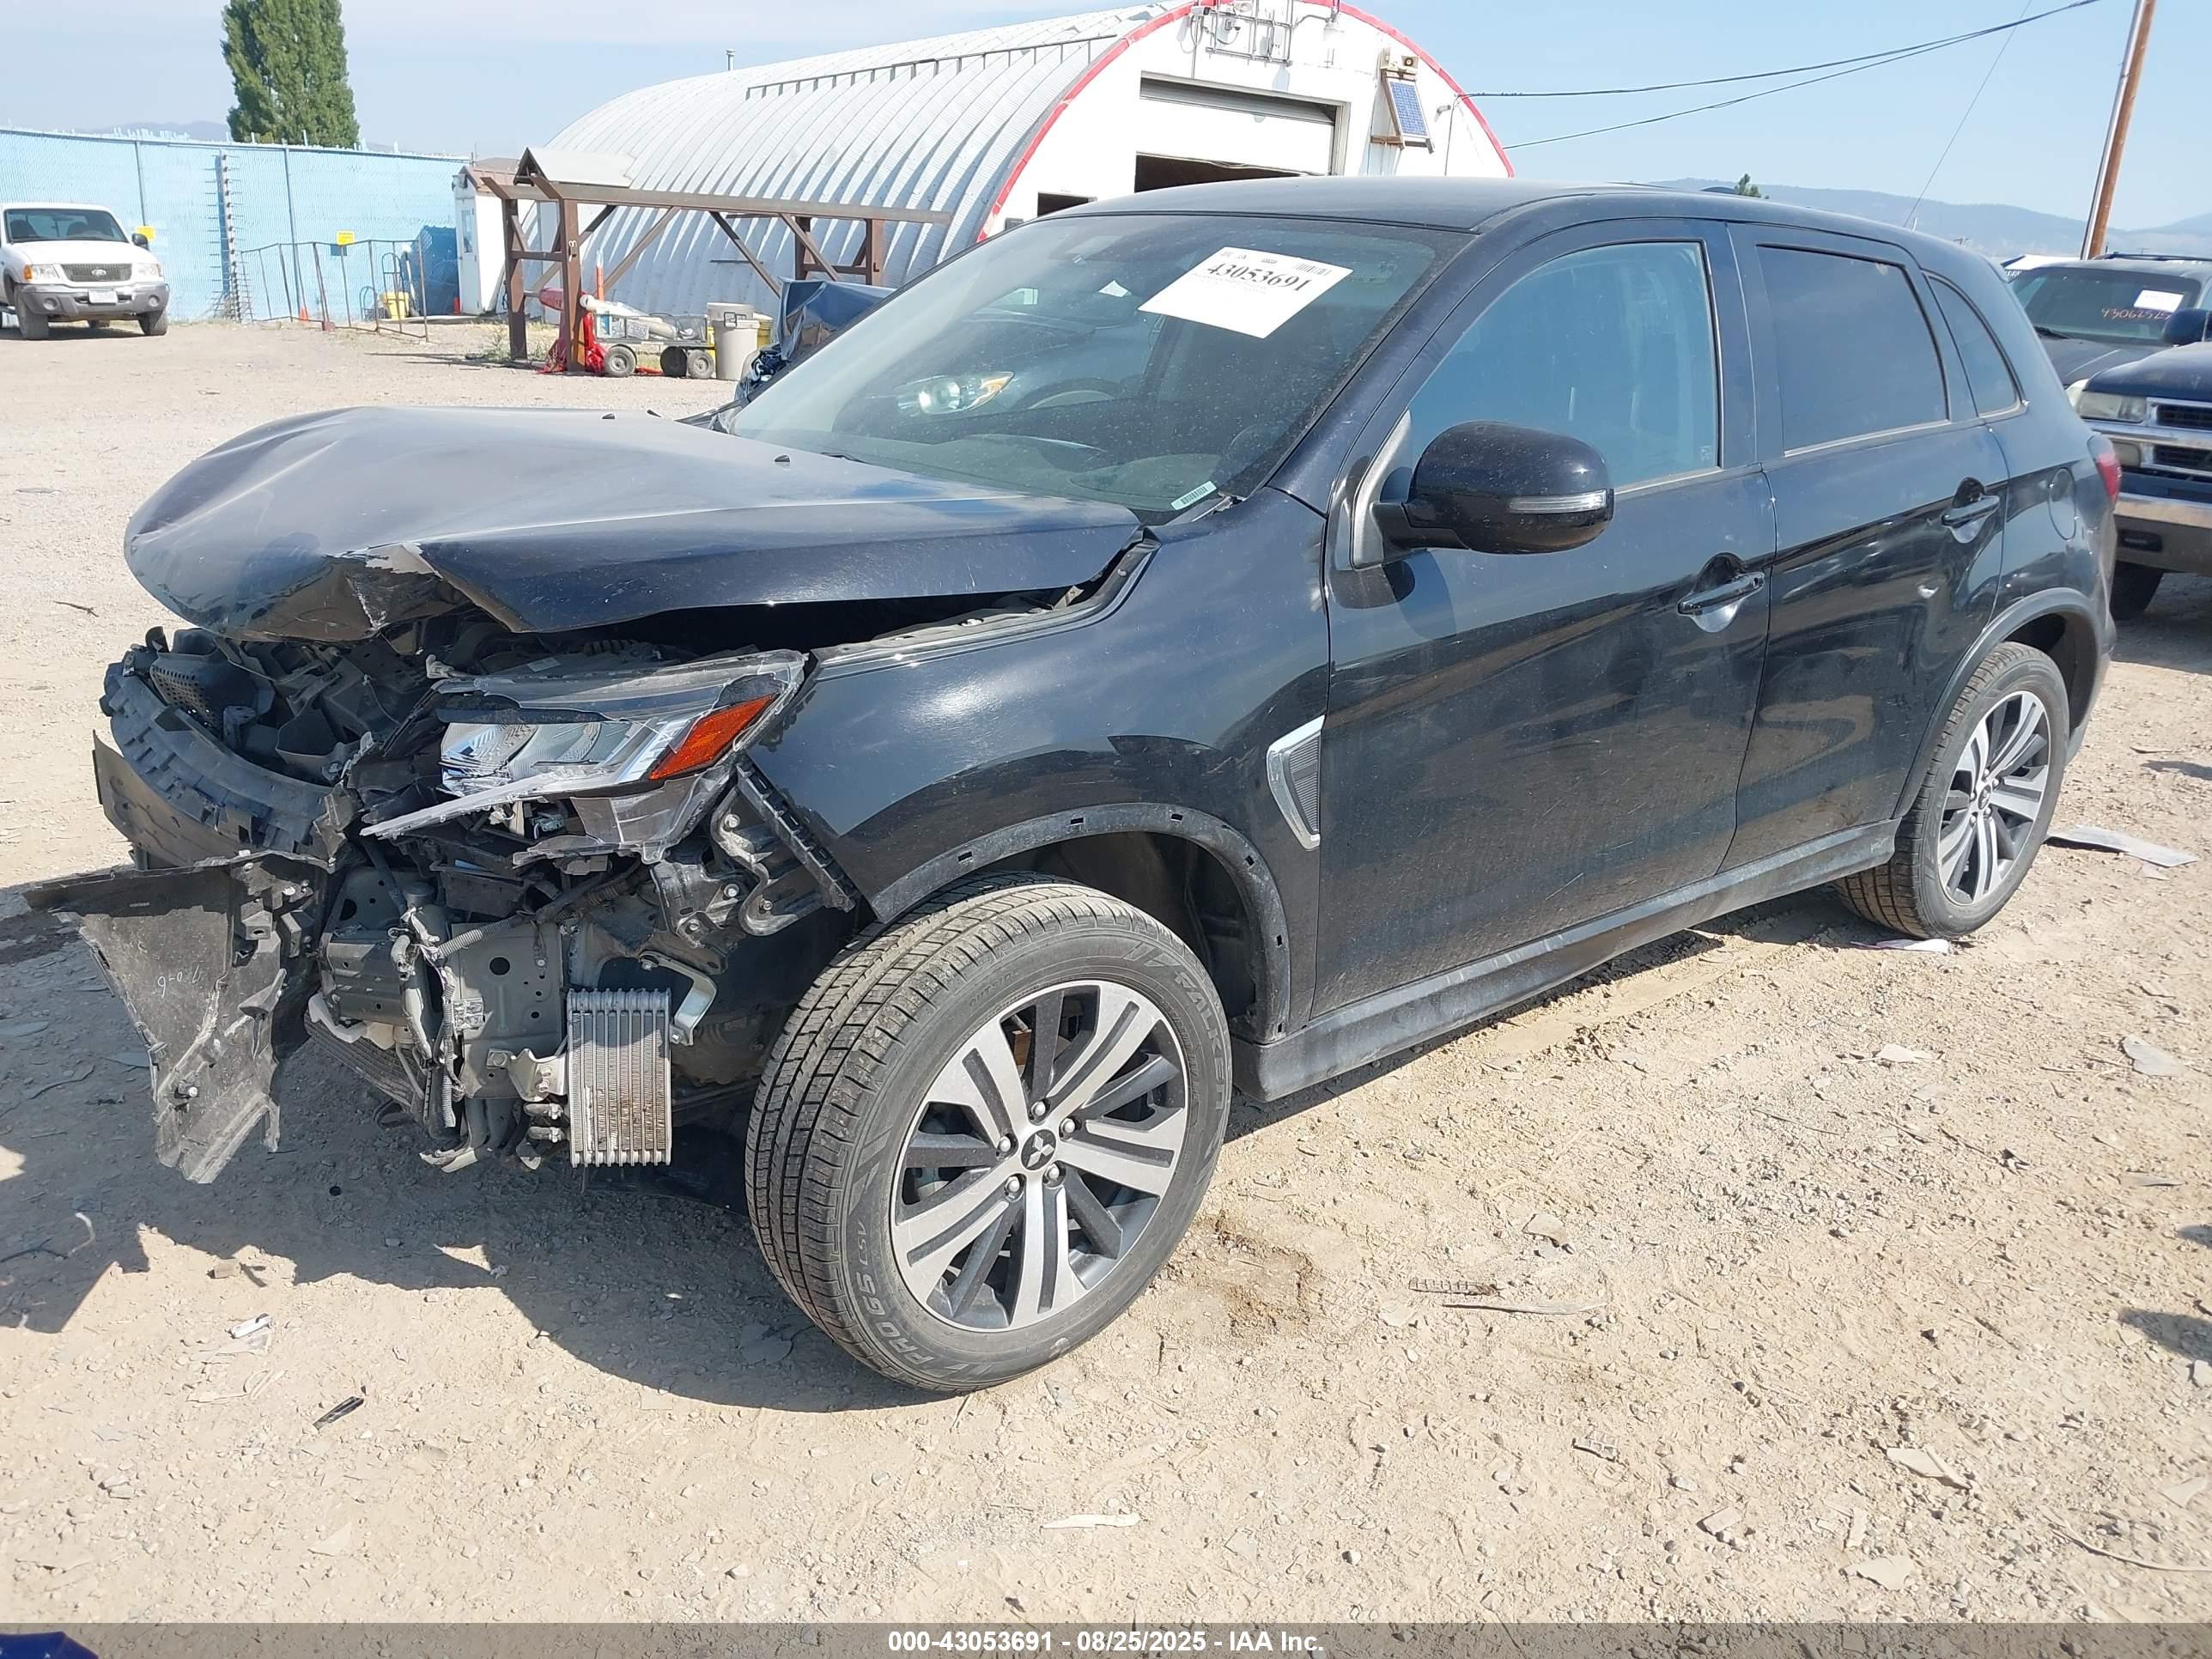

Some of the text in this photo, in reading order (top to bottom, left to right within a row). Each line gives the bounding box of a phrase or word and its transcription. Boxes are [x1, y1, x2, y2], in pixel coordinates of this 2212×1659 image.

[1207, 263, 1312, 291] 43053691
[1175, 969, 1225, 1109] FALKEN
[856, 1271, 886, 1316] G5
[875, 1322, 935, 1364] PRO
